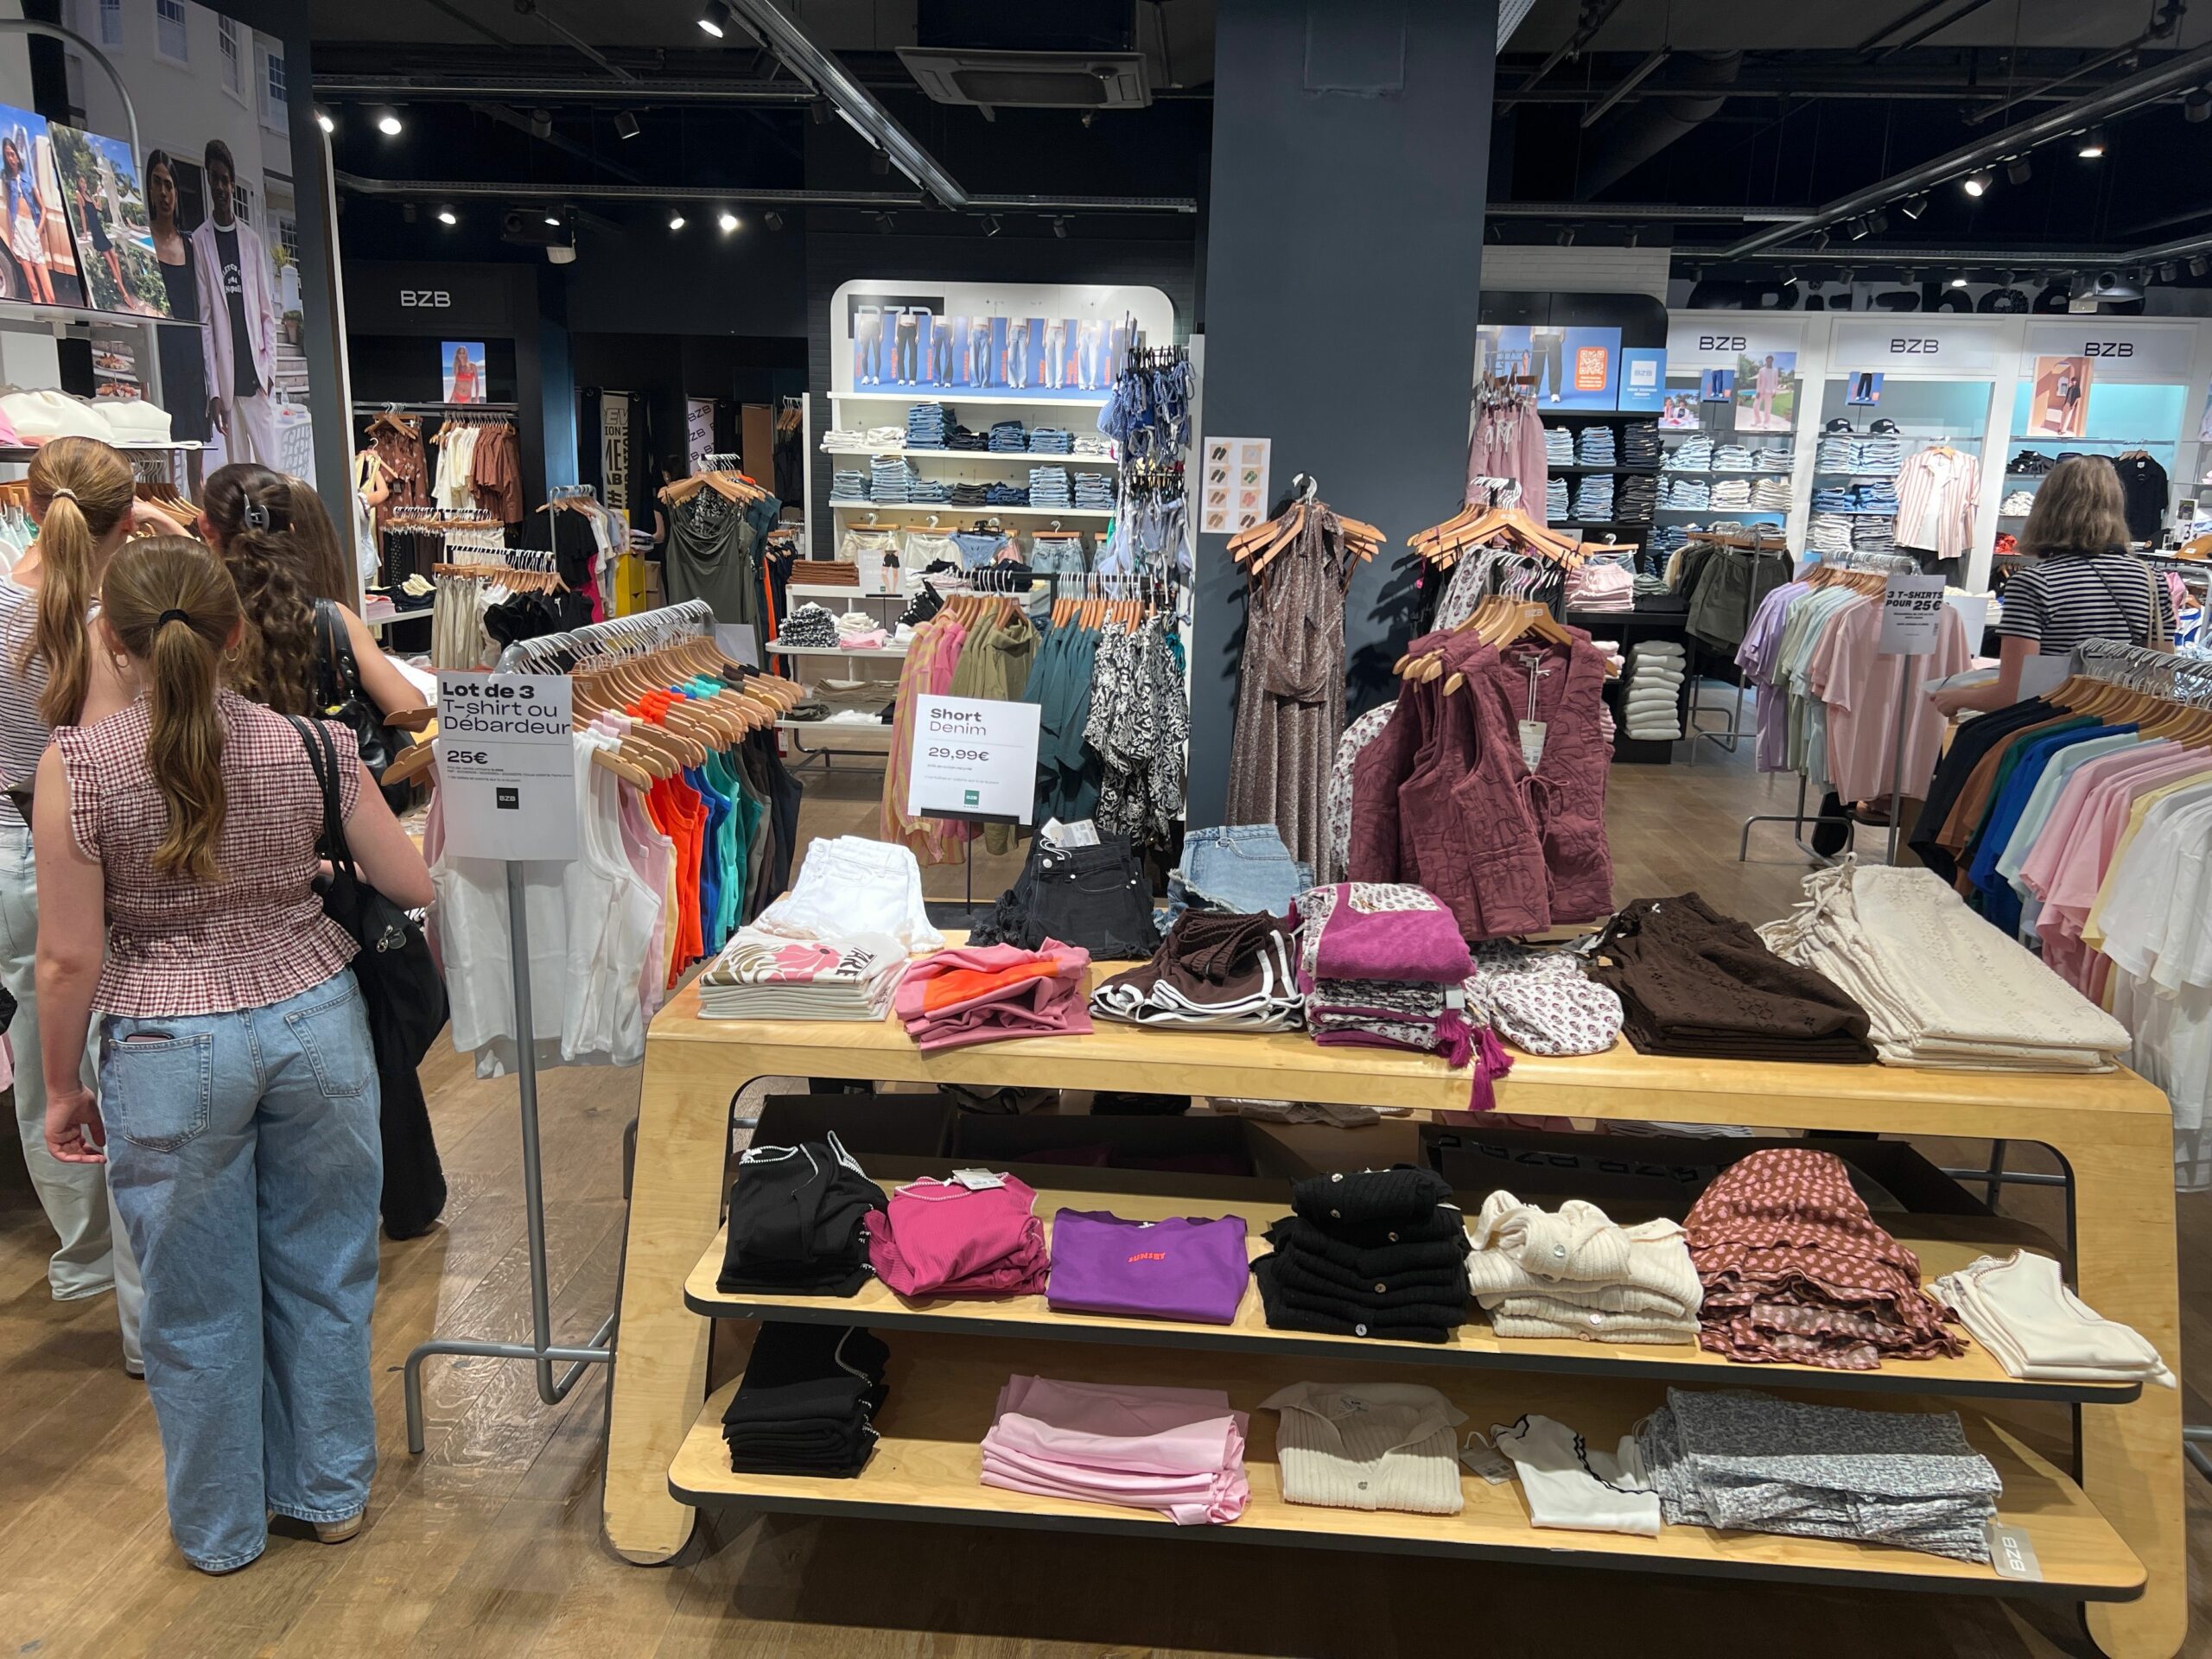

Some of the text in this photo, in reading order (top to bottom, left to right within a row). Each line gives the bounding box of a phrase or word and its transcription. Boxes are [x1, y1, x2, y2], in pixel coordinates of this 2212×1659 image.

[401, 290, 451, 307] BZB
[1699, 336, 1746, 351] BZB
[1890, 339, 1939, 353] BZB
[2084, 343, 2133, 358] BZB
[442, 682, 535, 699] Lot de 3
[443, 699, 557, 717] T-shirt ou
[931, 709, 982, 722] Short
[444, 714, 570, 734] Débardeur
[930, 721, 986, 735] Denim
[447, 750, 488, 765] 25€
[928, 747, 989, 761] 29,99€
[1128, 1252, 1166, 1262] SUNSET
[2002, 1537, 2026, 1572] BZB
